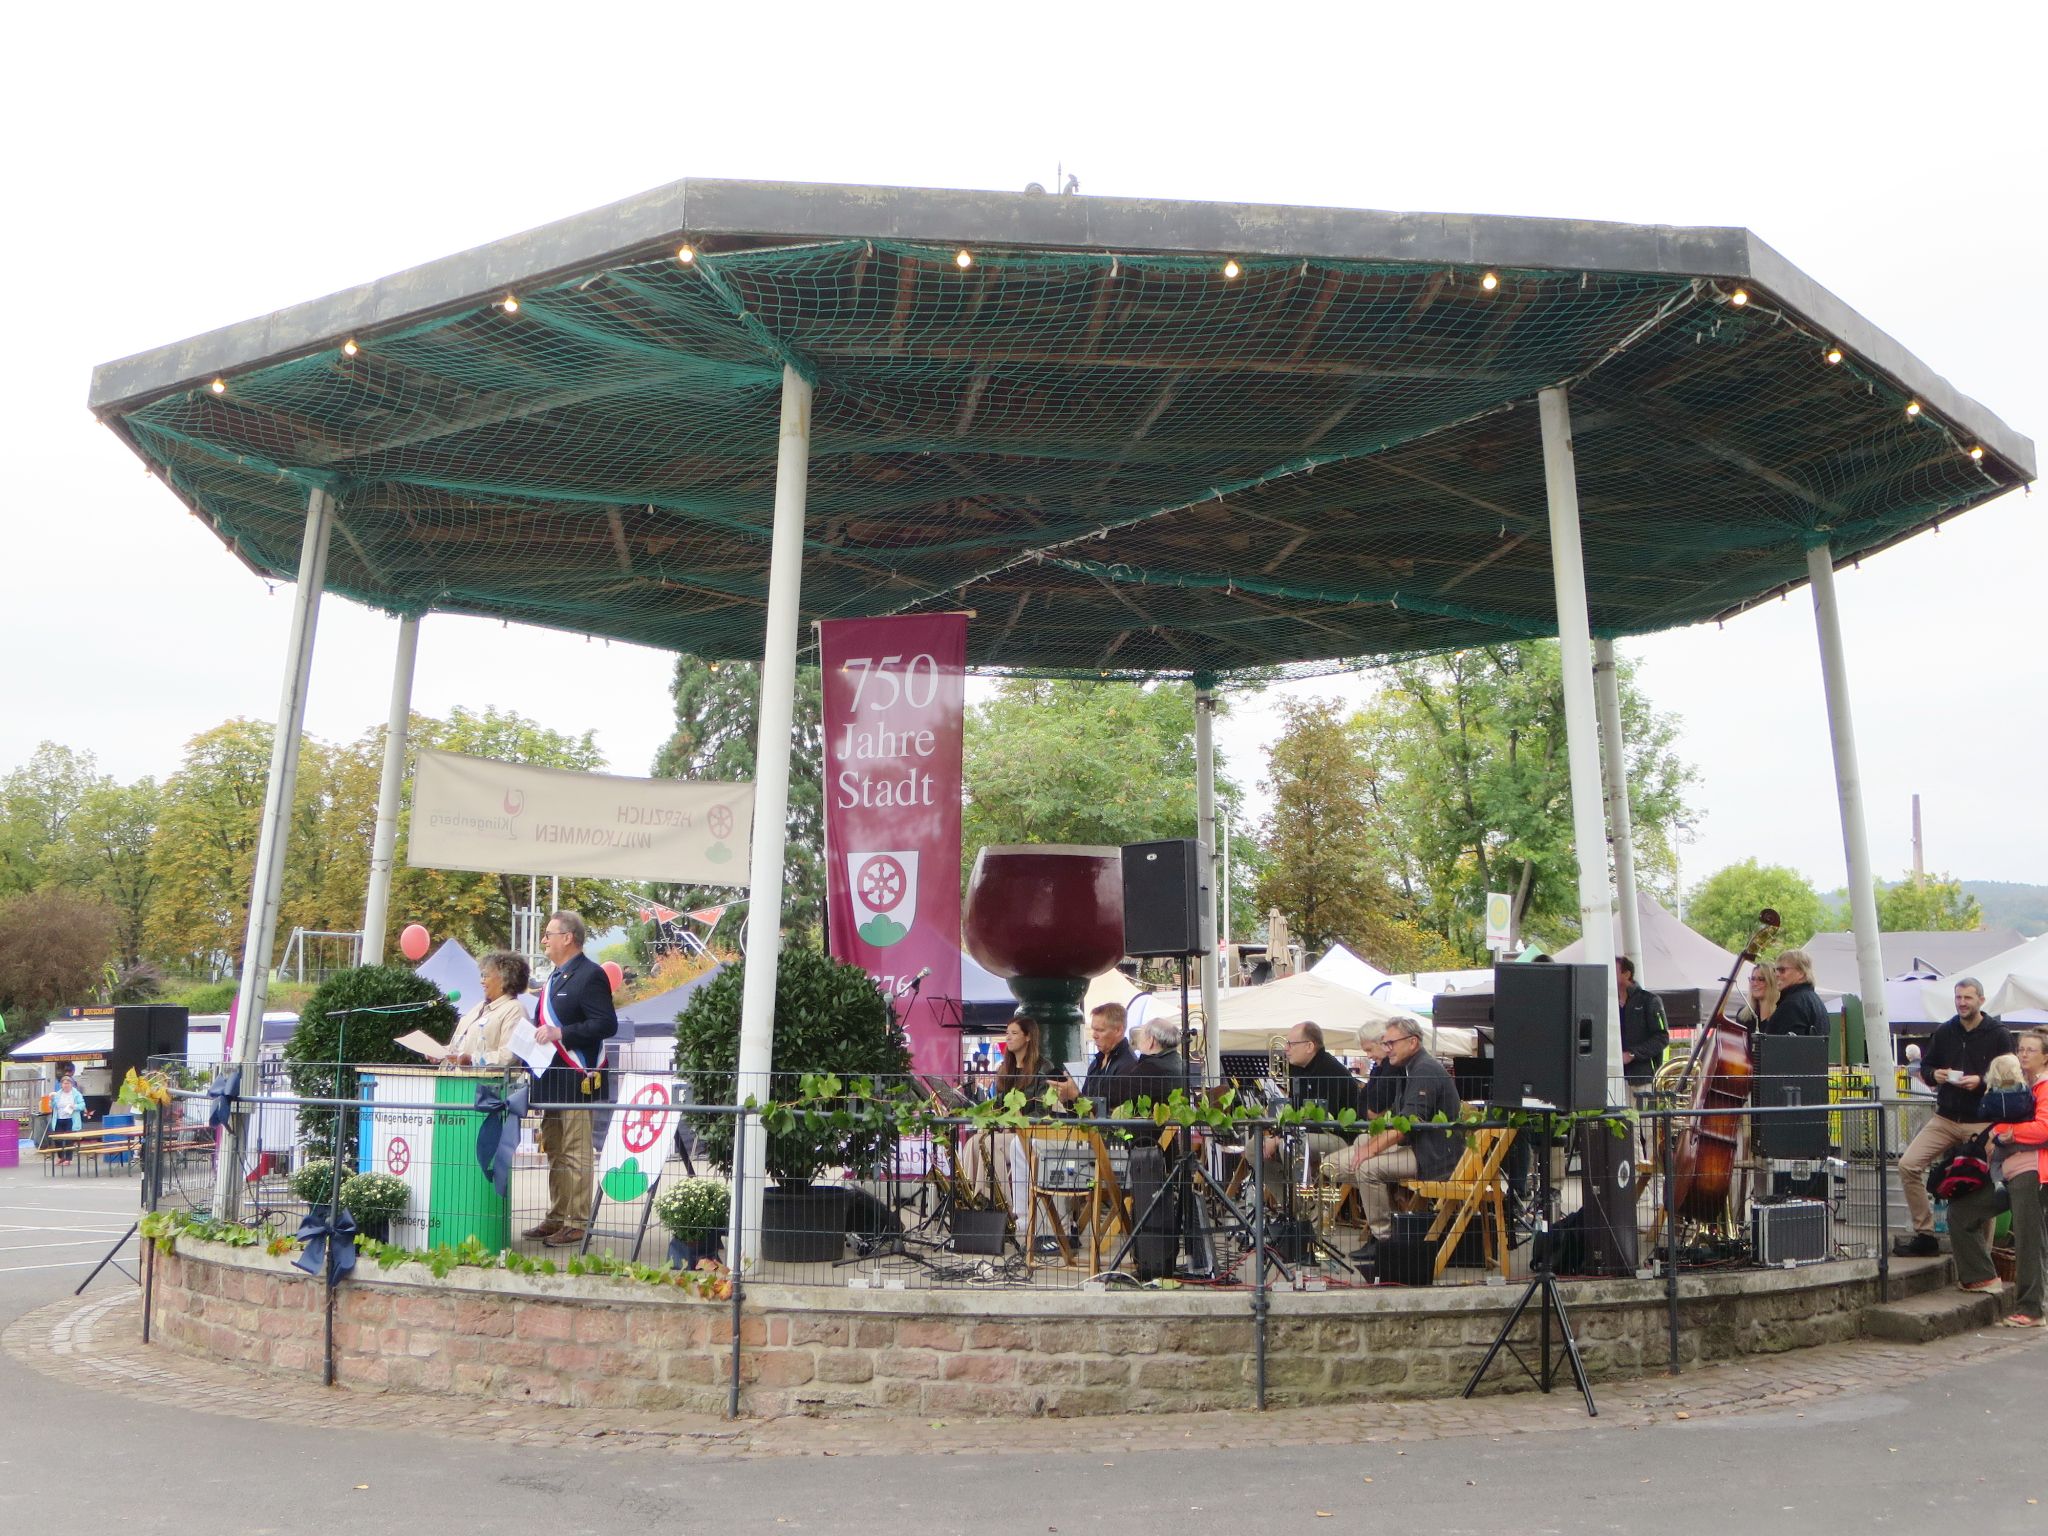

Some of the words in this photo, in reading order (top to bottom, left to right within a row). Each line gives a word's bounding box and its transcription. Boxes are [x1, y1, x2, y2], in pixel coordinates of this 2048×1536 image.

[842, 653, 939, 713] 750
[836, 722, 936, 760] Jahre
[837, 768, 936, 809] Stadt
[375, 1111, 423, 1126] Klingenberg
[426, 1115, 436, 1125] a.
[438, 1114, 466, 1126] Main
